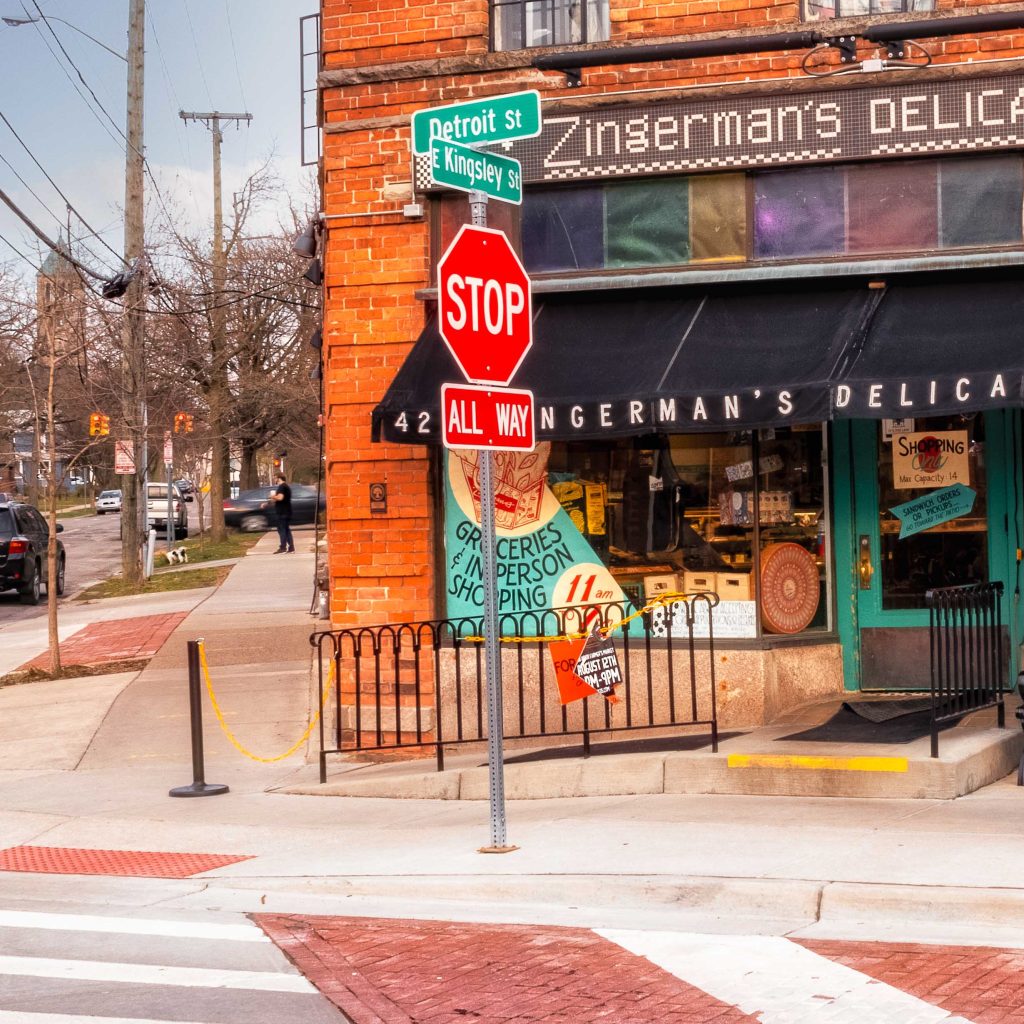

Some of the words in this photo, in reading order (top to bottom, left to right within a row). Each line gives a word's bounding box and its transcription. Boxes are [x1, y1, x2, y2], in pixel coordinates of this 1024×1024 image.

[429, 108, 497, 140] Detroit
[505, 109, 522, 130] St
[543, 100, 842, 168] Zingerman's
[432, 148, 440, 169] E
[444, 146, 503, 192] Kingsley
[507, 169, 520, 191] St
[446, 273, 525, 336] STOP
[394, 411, 431, 434] 42
[540, 388, 794, 430] NGERMAN'S
[448, 399, 484, 435] ALL
[495, 402, 529, 438] WAY
[898, 436, 965, 457] SHOPPING
[914, 474, 945, 485] Capacity
[903, 498, 935, 517] SANDWICH
[936, 488, 961, 504] ORDERS
[912, 513, 922, 522] OR
[455, 521, 562, 560] GRCERIES
[448, 573, 547, 611] SHOPING
[565, 573, 597, 603] 11
[595, 589, 614, 600] am
[555, 658, 576, 674] FOR
[584, 667, 621, 688] PM-9PM
